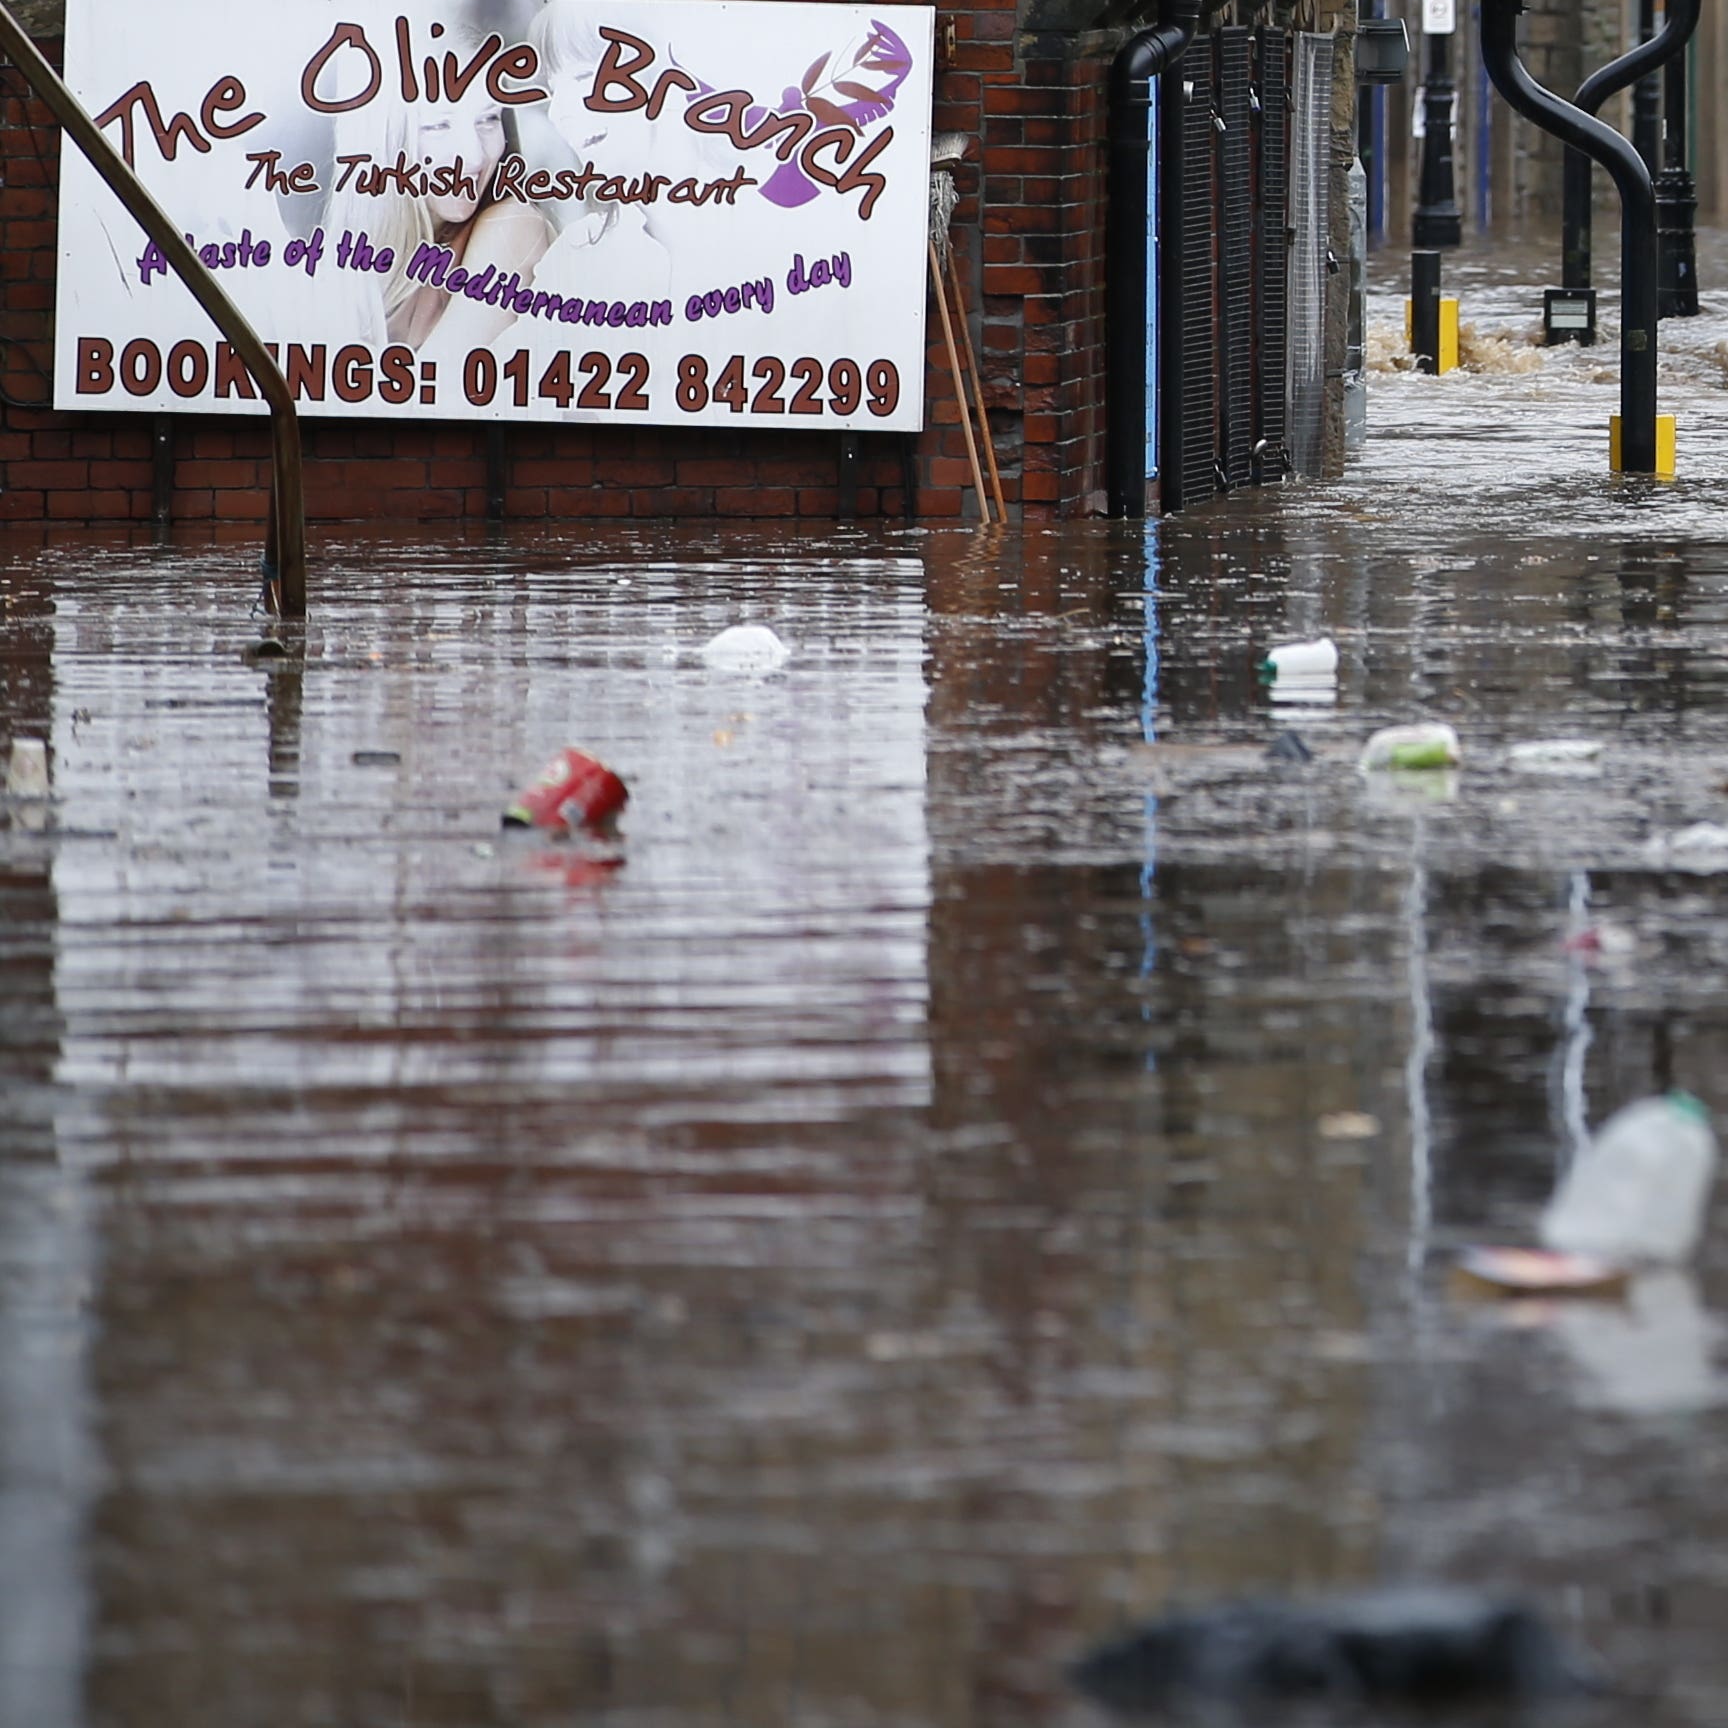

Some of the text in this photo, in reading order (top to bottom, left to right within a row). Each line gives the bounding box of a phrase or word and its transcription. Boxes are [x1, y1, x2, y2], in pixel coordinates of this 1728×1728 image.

[93, 15, 893, 220] The Olive Branch
[245, 150, 758, 206] The Turkish Restaurant
[283, 227, 325, 277] of
[337, 229, 395, 274] the
[405, 242, 674, 328] Mediterranean
[685, 277, 774, 322] every
[786, 251, 853, 295] day
[463, 348, 650, 411] 01422
[675, 353, 901, 417] 842299
